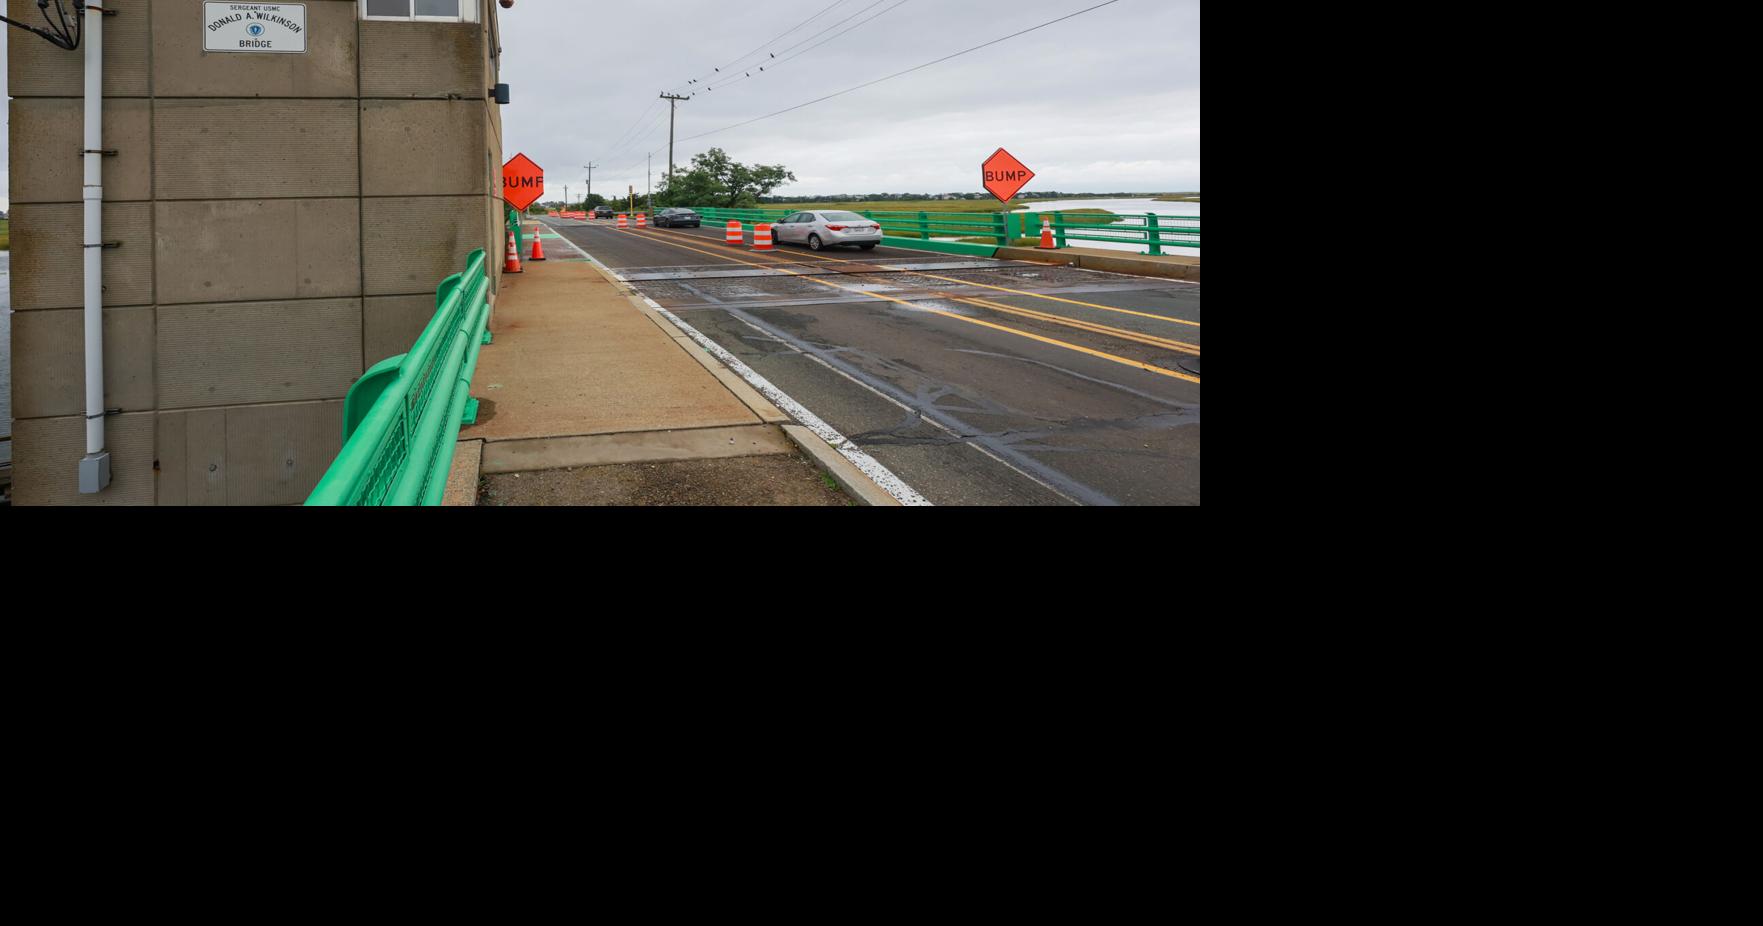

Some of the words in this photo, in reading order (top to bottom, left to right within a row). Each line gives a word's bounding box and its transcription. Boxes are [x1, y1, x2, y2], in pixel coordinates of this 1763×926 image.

[208, 13, 242, 32] DONALD
[256, 12, 302, 34] WILKINSON
[239, 40, 272, 48] BRIDGE
[985, 171, 1026, 182] BUMP
